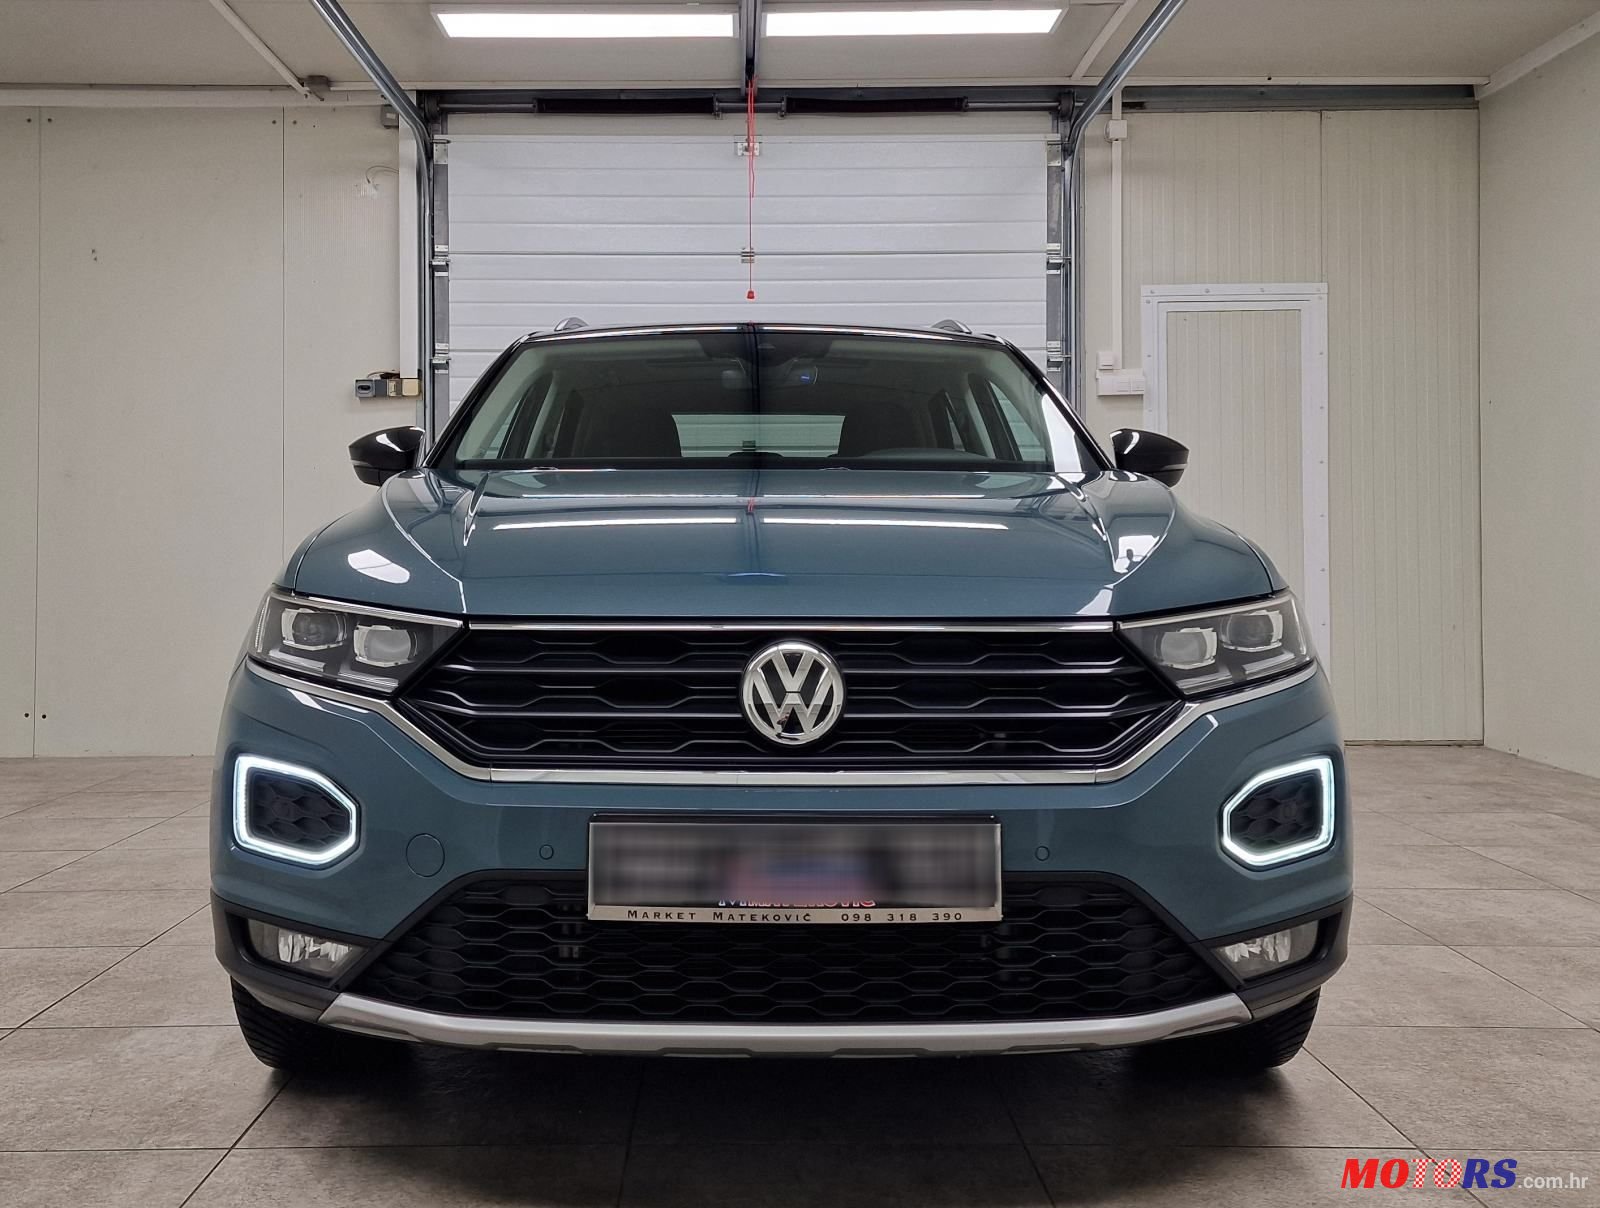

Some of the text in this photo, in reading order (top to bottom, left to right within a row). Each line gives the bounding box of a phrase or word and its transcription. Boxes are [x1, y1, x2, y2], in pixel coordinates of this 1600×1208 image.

[627, 909, 696, 920] MARKET
[840, 913, 872, 922] 098
[886, 913, 917, 922] 318
[931, 912, 962, 921] 390
